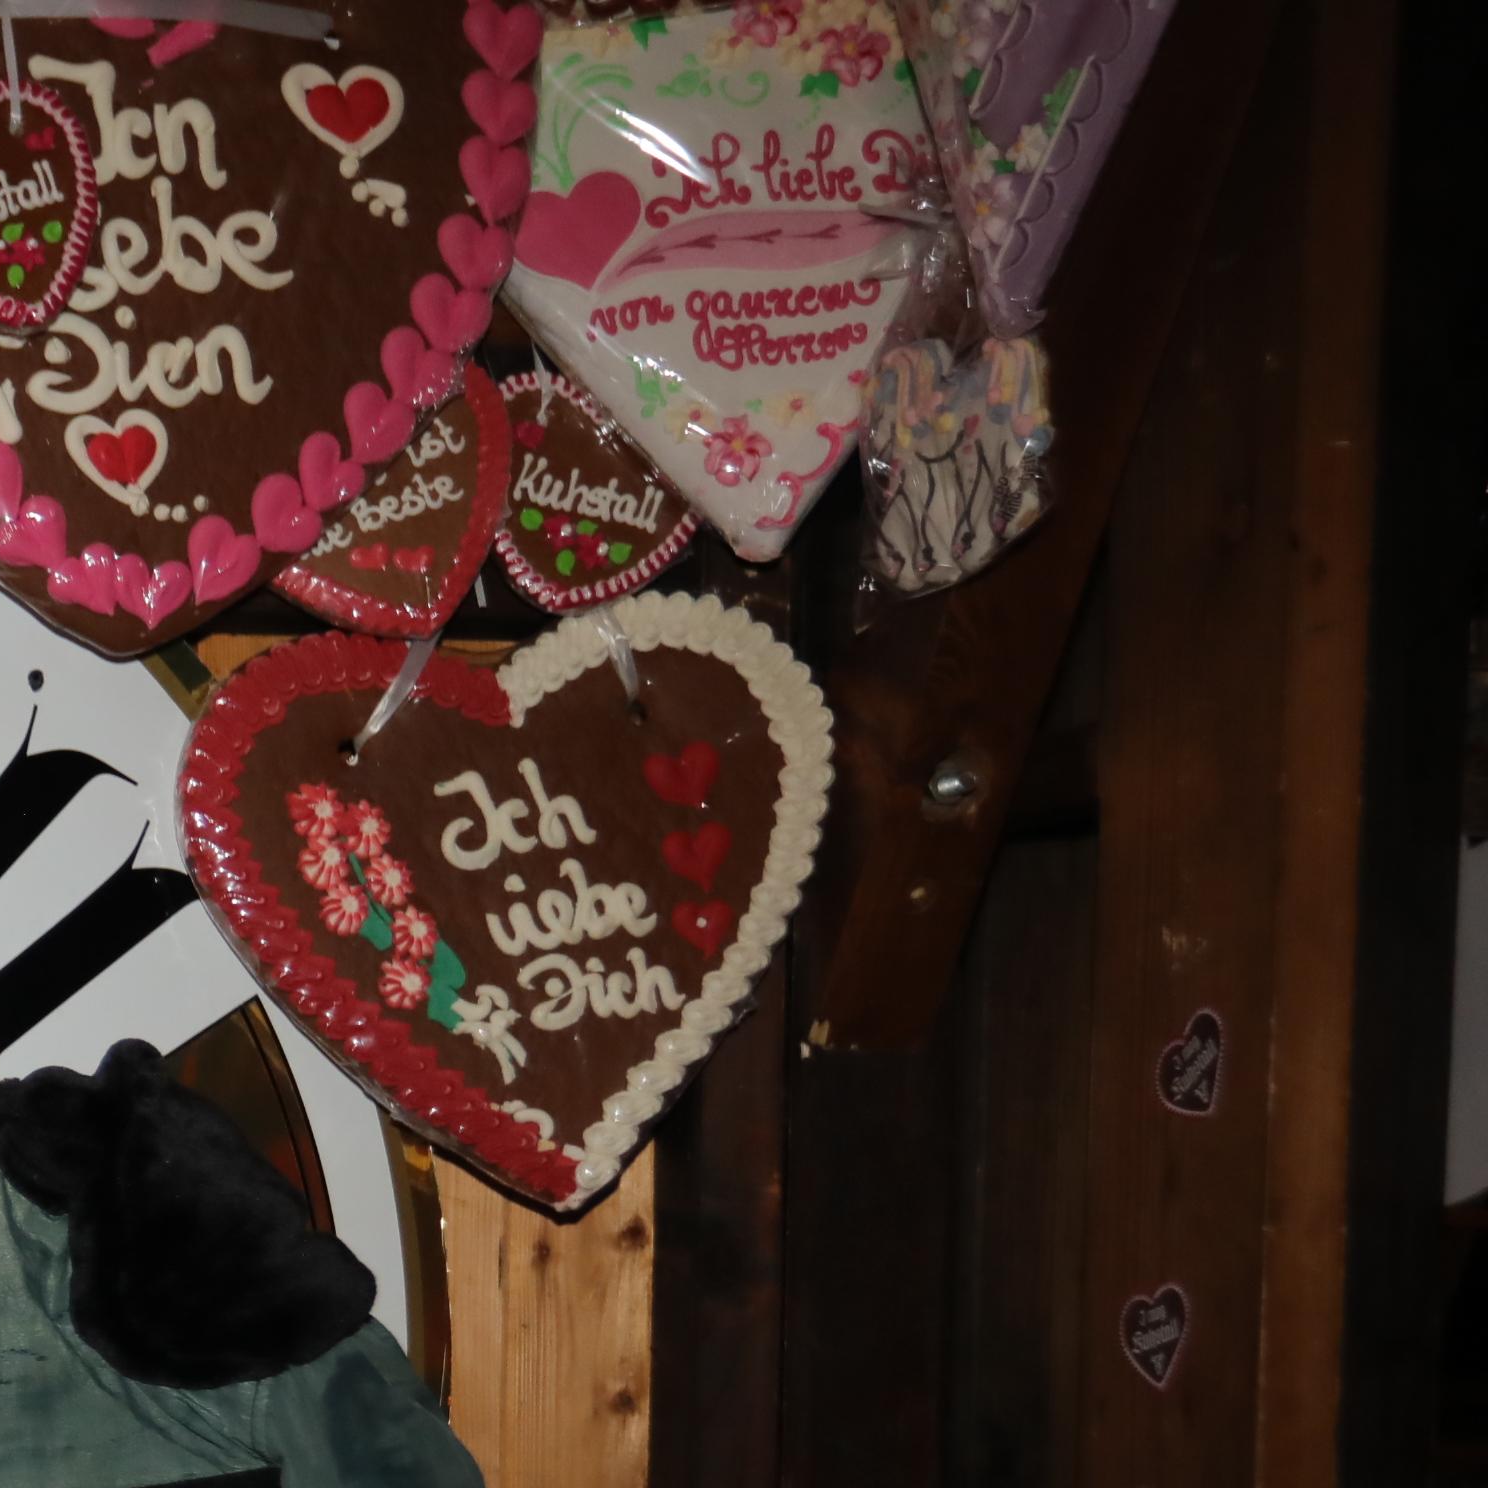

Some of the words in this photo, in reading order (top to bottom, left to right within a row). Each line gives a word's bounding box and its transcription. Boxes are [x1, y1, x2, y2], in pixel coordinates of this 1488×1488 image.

[751, 124, 862, 201] liebe
[587, 296, 674, 342] von
[350, 473, 464, 533] Beste
[513, 453, 664, 534] Kuhstall
[434, 757, 597, 870] Ich
[517, 947, 686, 1031] Dich
